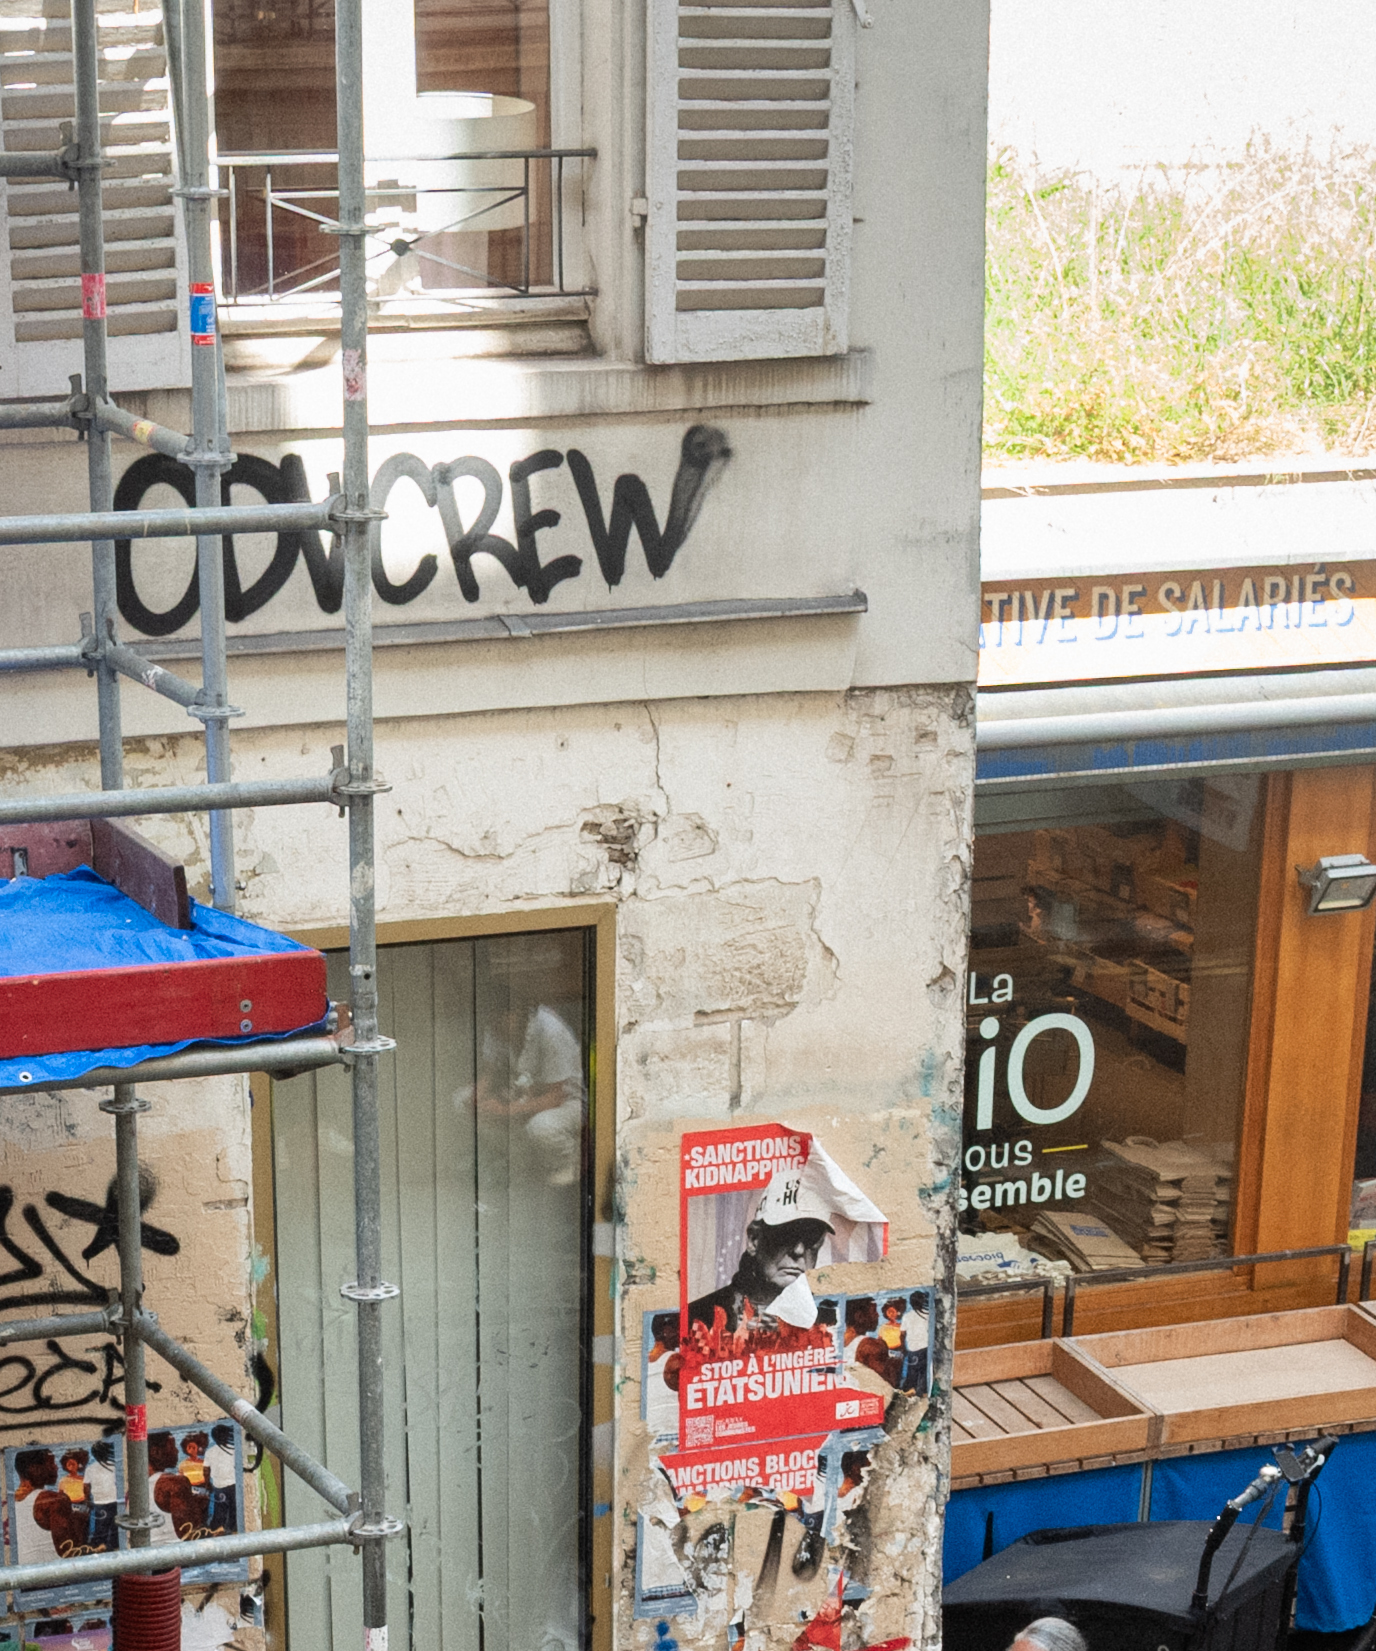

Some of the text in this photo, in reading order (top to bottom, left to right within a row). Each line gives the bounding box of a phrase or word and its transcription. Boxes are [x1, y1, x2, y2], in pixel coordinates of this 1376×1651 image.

[1092, 584, 1147, 641] DE
[1158, 563, 1356, 637] SALARIÉS
[969, 971, 1014, 1005] La
[690, 1136, 802, 1167] SANCTIONS
[685, 1156, 805, 1189] KIDNAPPING
[701, 1346, 839, 1381] STOP À L'INGÉRE
